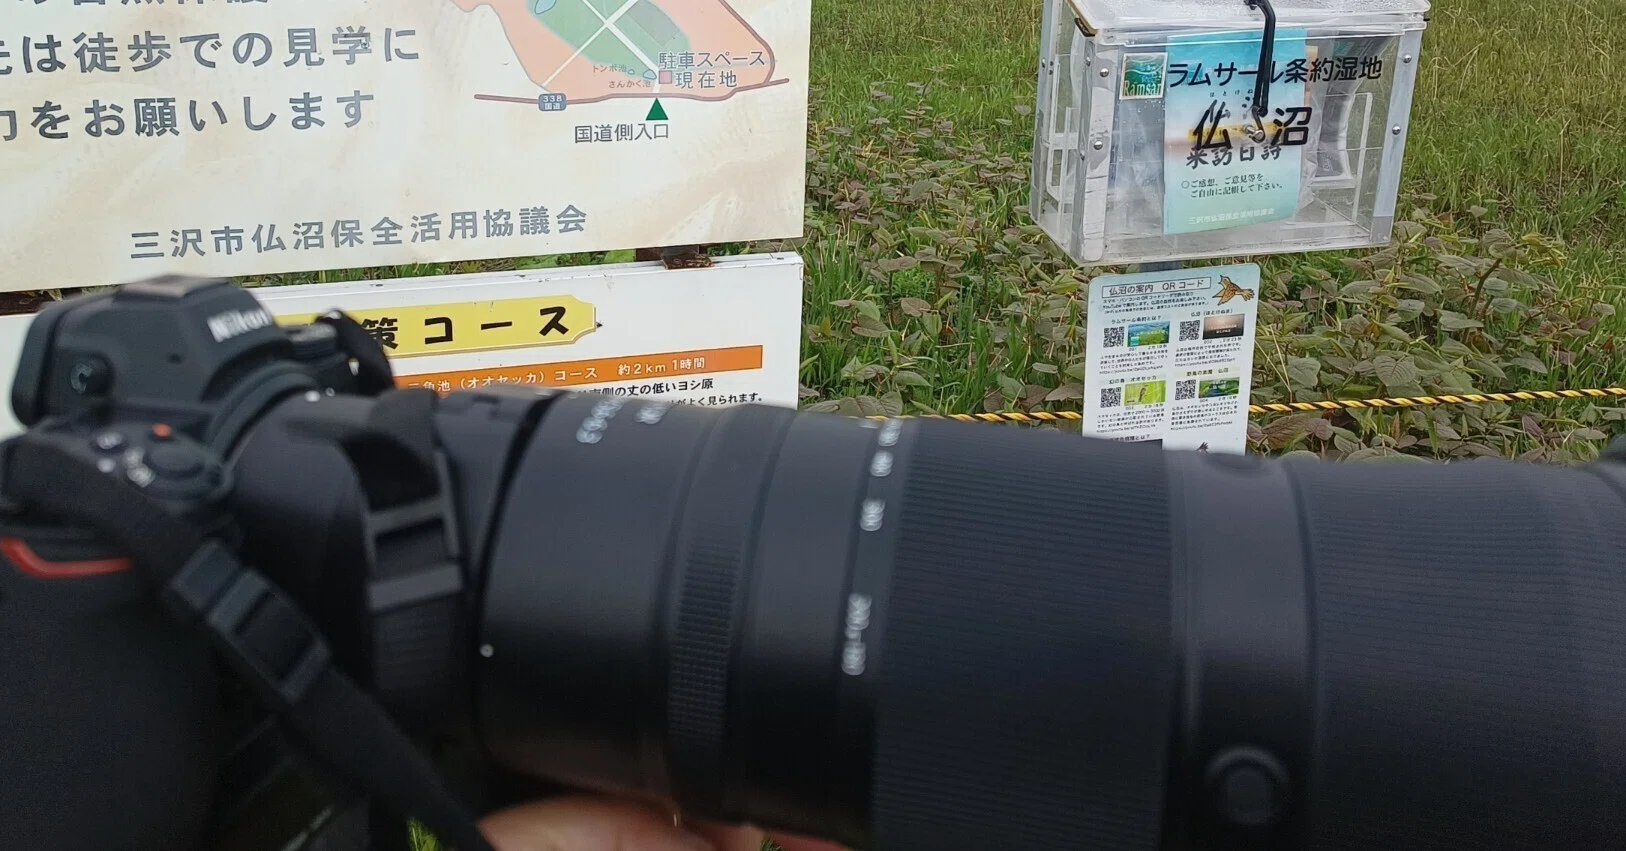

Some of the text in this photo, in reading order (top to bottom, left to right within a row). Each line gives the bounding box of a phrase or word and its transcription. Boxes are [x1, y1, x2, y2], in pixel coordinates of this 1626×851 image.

[592, 64, 628, 74] トンボ池
[658, 51, 766, 70] 駐車スペース
[675, 70, 738, 89] 現在地
[1169, 57, 1383, 89] ラムサール条約湿地
[608, 79, 651, 89] さんかく池
[1123, 80, 1162, 97] Ramsar
[542, 95, 563, 103] 338
[544, 102, 562, 110] 国道
[574, 123, 669, 144] 国道側入口
[1193, 106, 1313, 151] 仏沼
[130, 204, 588, 260] 三沢市仏沼保全活用協議会
[1109, 284, 1154, 296] 仏沼の案内
[579, 377, 714, 397] 側の丈の低いヨシ原
[667, 392, 763, 406] がよく見られます。
